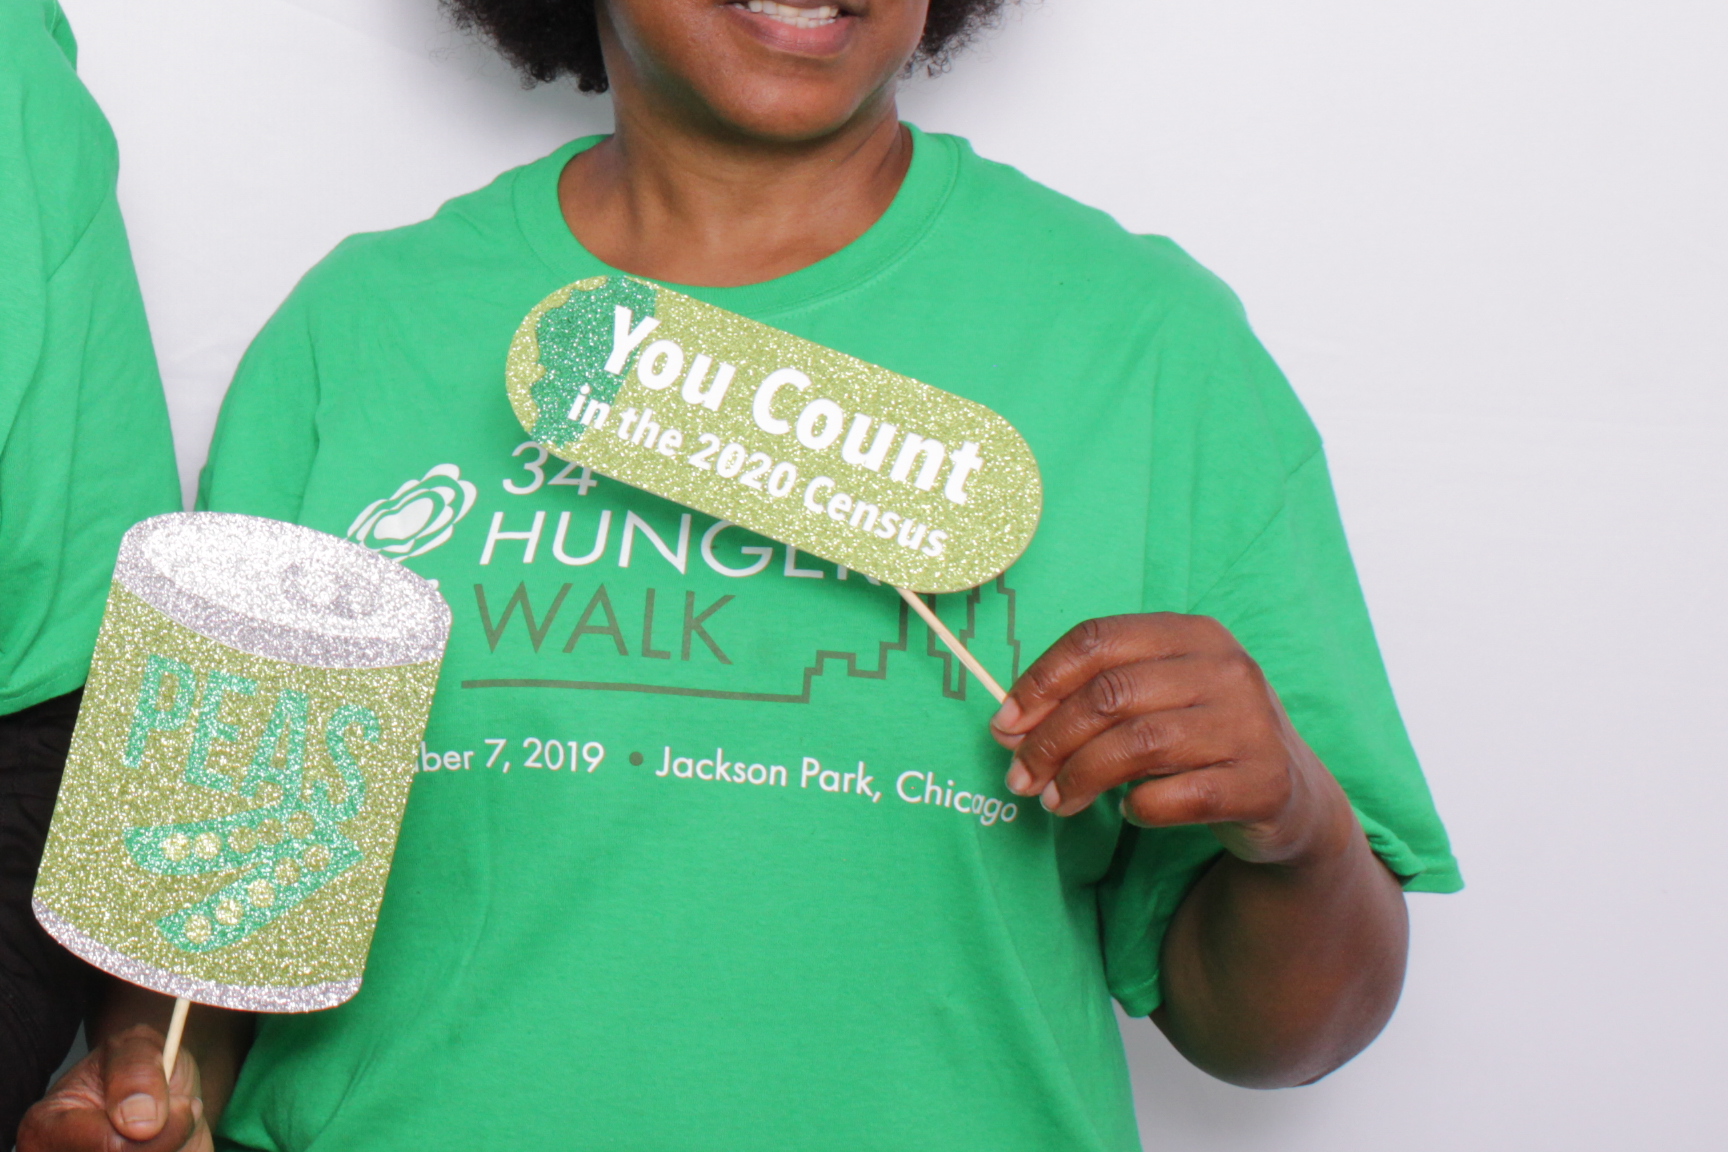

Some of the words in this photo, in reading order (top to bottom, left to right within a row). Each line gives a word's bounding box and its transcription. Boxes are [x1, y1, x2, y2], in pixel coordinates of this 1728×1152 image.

[566, 383, 612, 431] in
[616, 406, 684, 456] the
[687, 432, 798, 499] 2020
[803, 474, 950, 558] Census
[603, 304, 737, 412] You
[751, 366, 984, 506] Count
[473, 580, 738, 666] WALK
[122, 654, 381, 824] PEAS
[483, 738, 511, 774] 7,
[523, 737, 606, 773] 2019
[655, 746, 788, 787] Jackson
[800, 756, 882, 803] Park,
[895, 770, 1019, 826] Chicago
